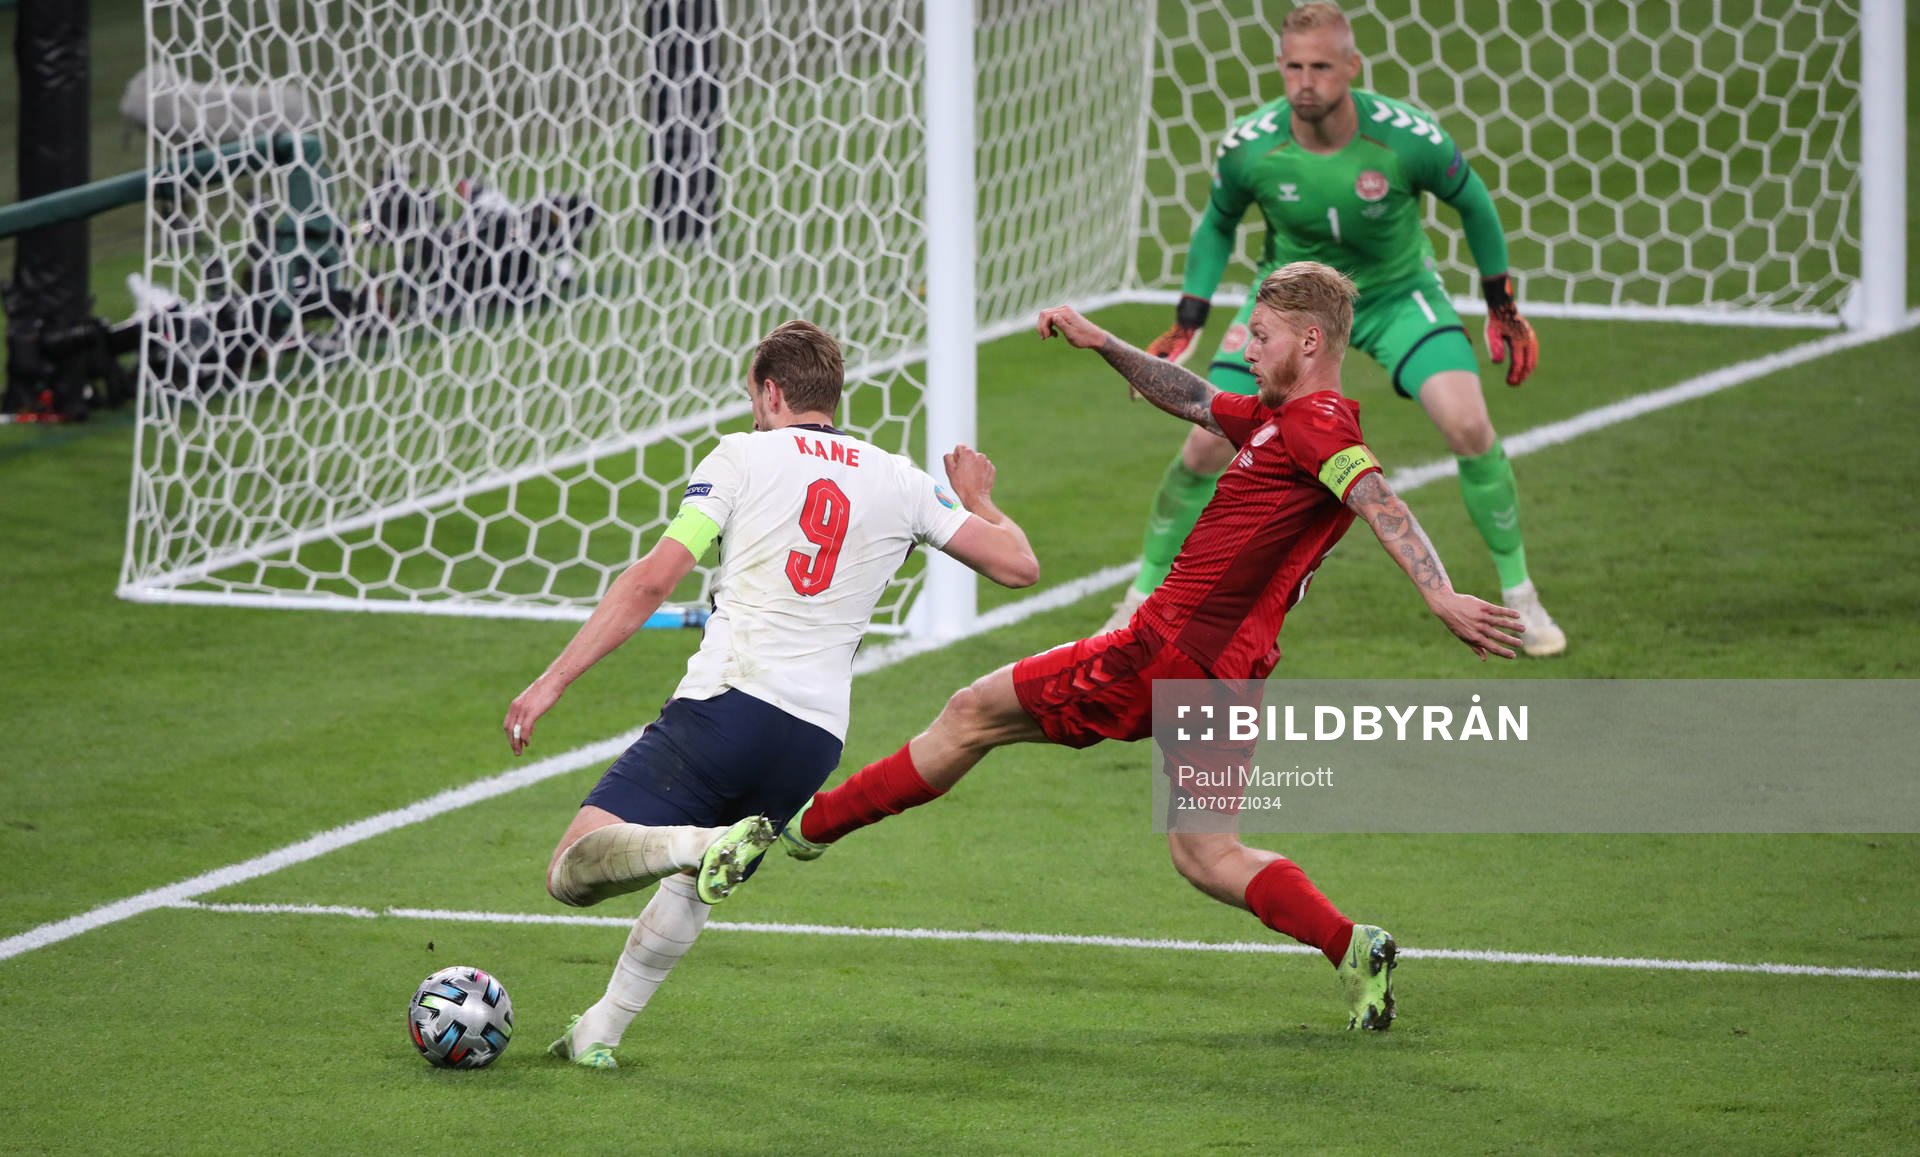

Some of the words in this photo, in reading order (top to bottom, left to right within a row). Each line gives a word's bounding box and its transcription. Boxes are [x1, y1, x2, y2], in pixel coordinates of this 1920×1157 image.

[1327, 207, 1340, 243] 1
[1411, 290, 1437, 323] 1
[794, 436, 859, 467] KANE
[1336, 457, 1366, 485] RESPECT
[785, 478, 850, 597] 9
